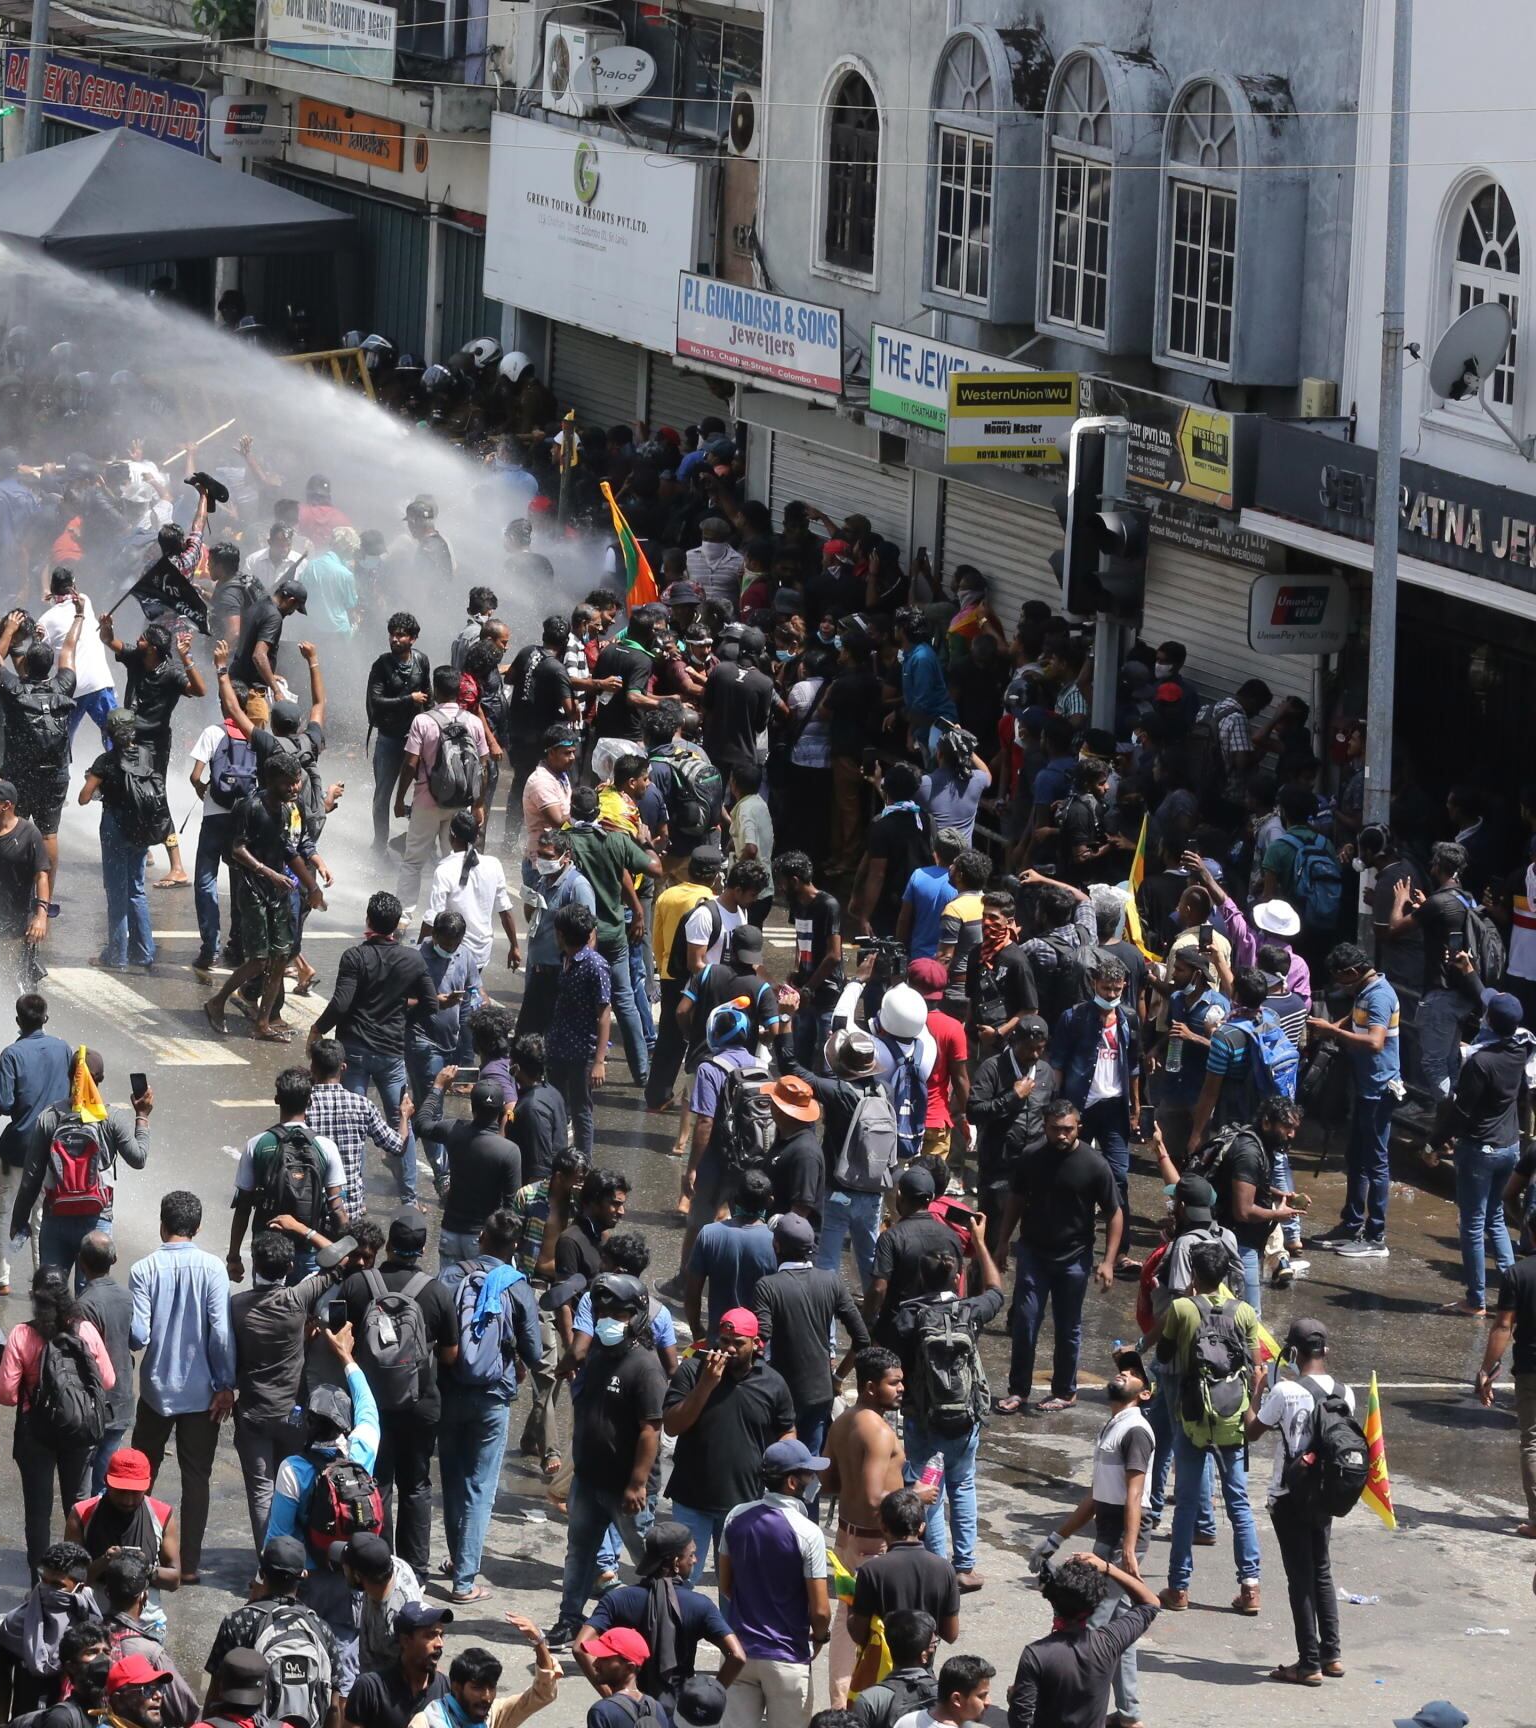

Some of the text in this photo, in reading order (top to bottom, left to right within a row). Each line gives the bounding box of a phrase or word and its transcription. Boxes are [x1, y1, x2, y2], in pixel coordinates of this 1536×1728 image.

[6, 53, 201, 143] RAEK'S GEMS (PVT) LTD.
[526, 192, 549, 206] GREEN
[551, 198, 573, 214] TOURS
[583, 206, 614, 224] RESORTS
[784, 306, 795, 335] &
[797, 307, 838, 349] SONS
[729, 325, 795, 357] Jewellers
[878, 336, 911, 381] THE
[778, 368, 812, 384] Colombo
[961, 388, 1044, 400] WesternUnion
[912, 404, 938, 421] CHATHAM
[984, 424, 1042, 435] Money Master
[1128, 422, 1172, 446] ART (PVT) LTD.
[977, 450, 1046, 459] ROYAL MONEY MART
[1165, 527, 1182, 542] Money
